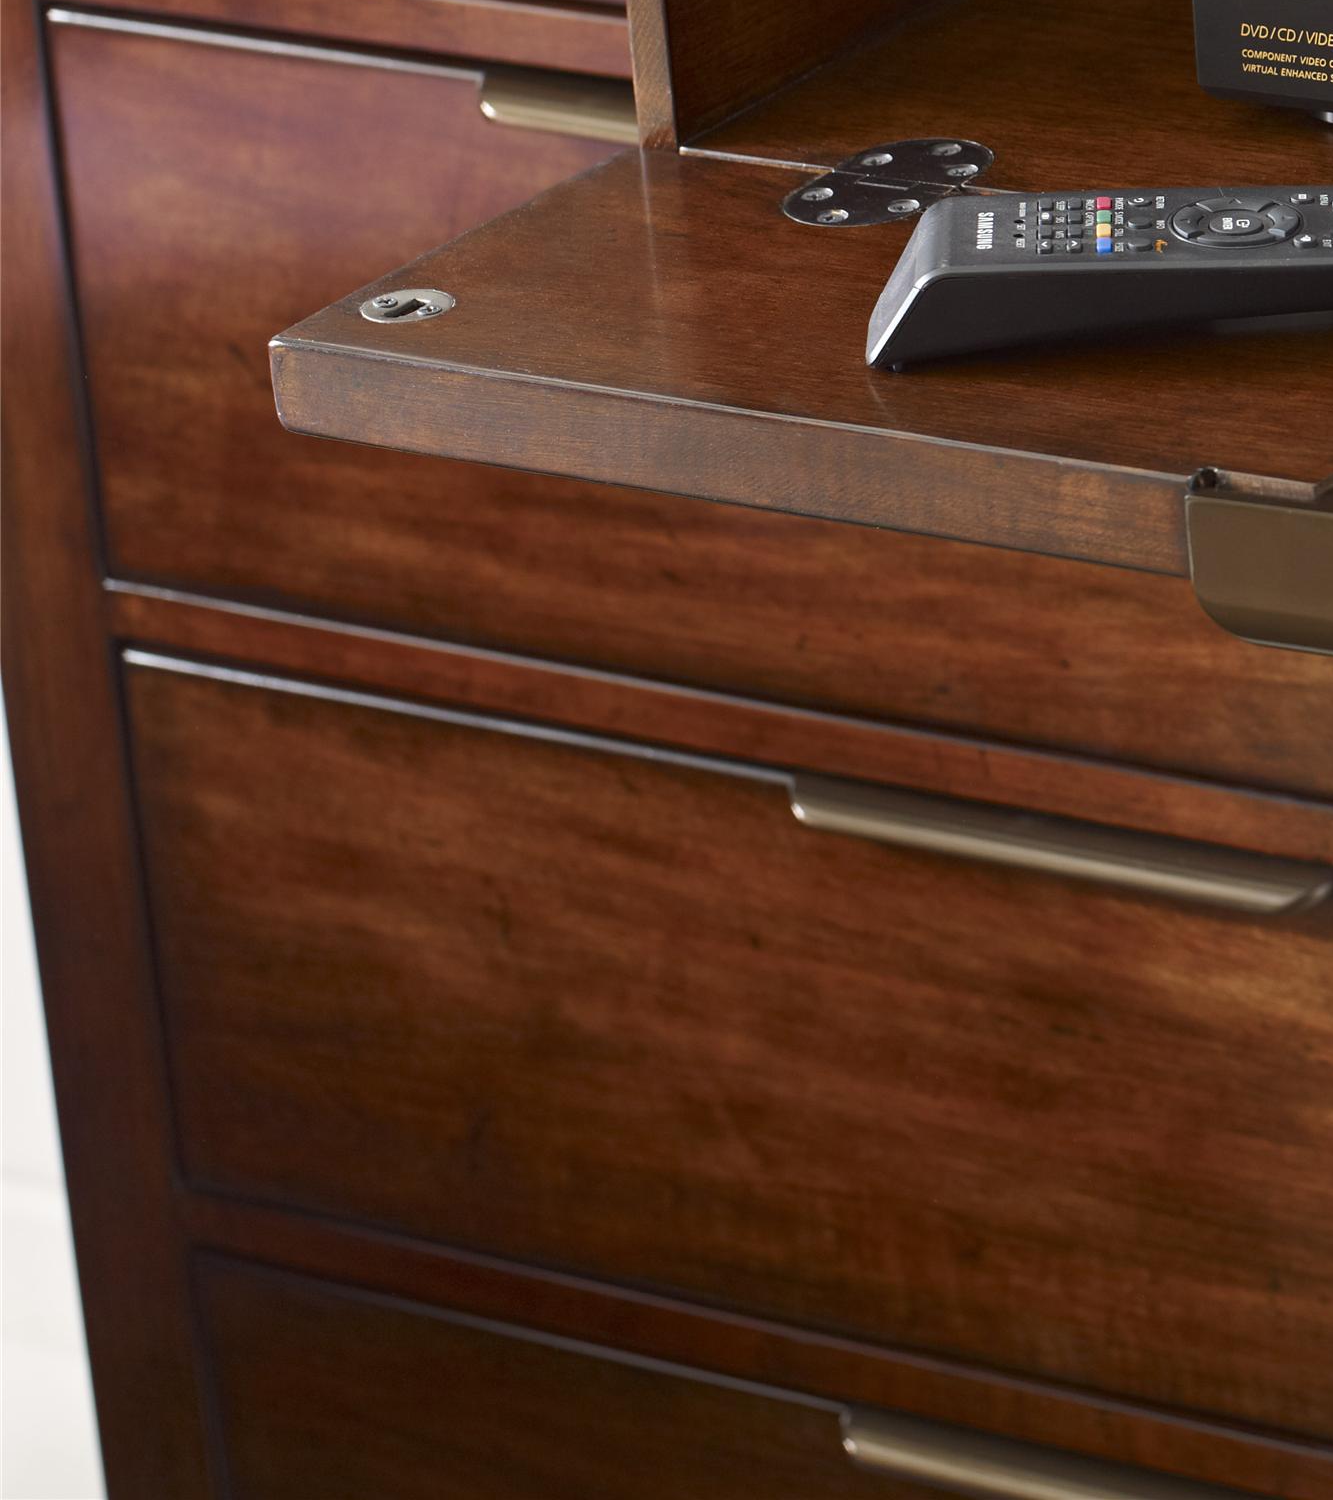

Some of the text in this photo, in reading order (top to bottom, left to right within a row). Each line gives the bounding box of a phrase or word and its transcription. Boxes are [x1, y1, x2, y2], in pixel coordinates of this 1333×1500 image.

[1241, 48, 1298, 64] COMPONENT
[1300, 56, 1327, 68] VIDEO
[1242, 63, 1279, 76] VIRTUAL
[1281, 67, 1328, 82] ENHANCED
[1319, 194, 1329, 206] MENU
[976, 211, 995, 250] SAMSUNG
[1156, 220, 1165, 230] INFO
